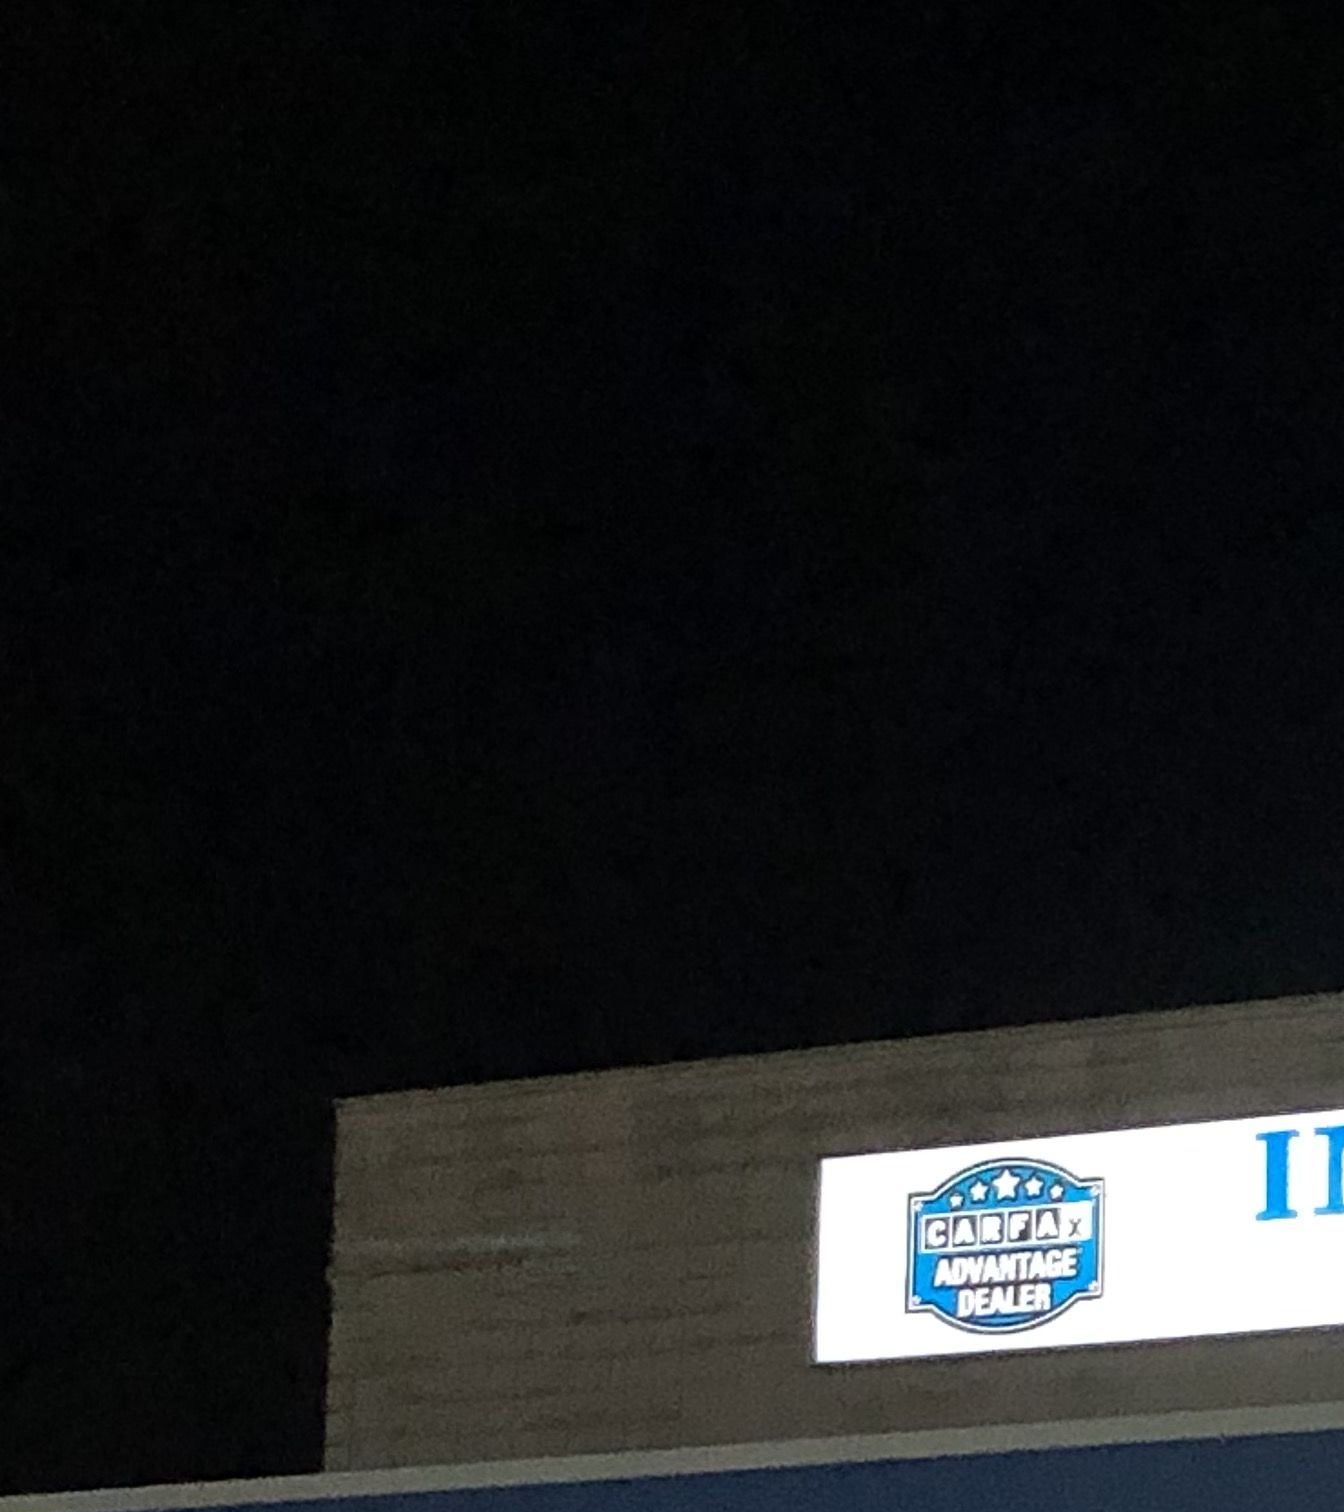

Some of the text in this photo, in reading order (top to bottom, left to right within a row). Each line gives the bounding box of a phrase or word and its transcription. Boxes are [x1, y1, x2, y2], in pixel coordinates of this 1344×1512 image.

[924, 1206, 1082, 1250] CARFAX
[933, 1247, 1078, 1288] ADVANTAGE
[956, 1281, 1052, 1319] DEALER
